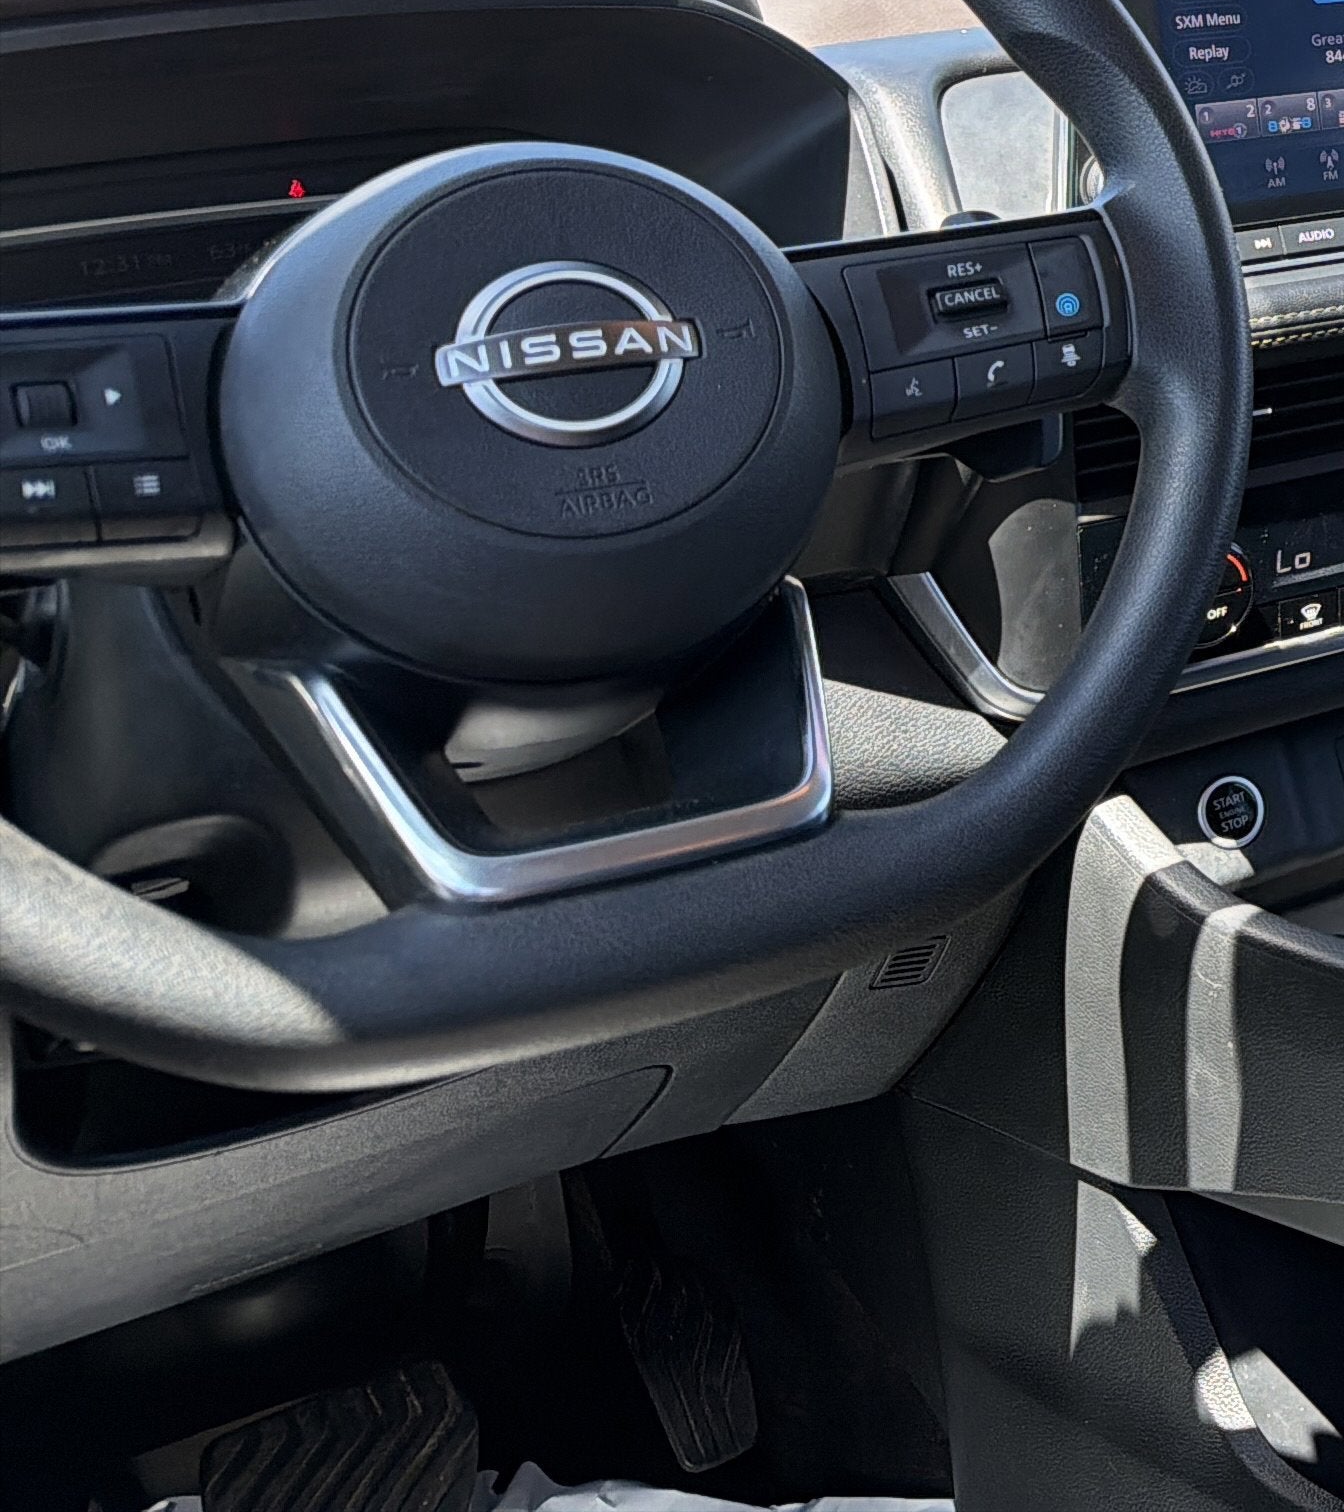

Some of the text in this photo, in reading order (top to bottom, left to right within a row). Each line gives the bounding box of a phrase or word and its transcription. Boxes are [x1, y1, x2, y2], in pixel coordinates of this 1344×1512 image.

[1175, 12, 1241, 29] SXM Menu
[1188, 44, 1230, 62] Replay
[1246, 104, 1256, 118] 2
[1264, 104, 1272, 115] 2
[1306, 97, 1316, 111] 8
[1267, 176, 1287, 188] AM
[1323, 170, 1339, 181] FM
[1298, 226, 1336, 244] AUDIO
[946, 260, 983, 278] RES+
[944, 285, 1000, 307] CANCEL
[962, 323, 998, 339] SET-
[445, 319, 697, 381] NISSAN
[1206, 605, 1228, 620] OFF
[1212, 791, 1245, 811] START
[1220, 814, 1249, 833] STOP
